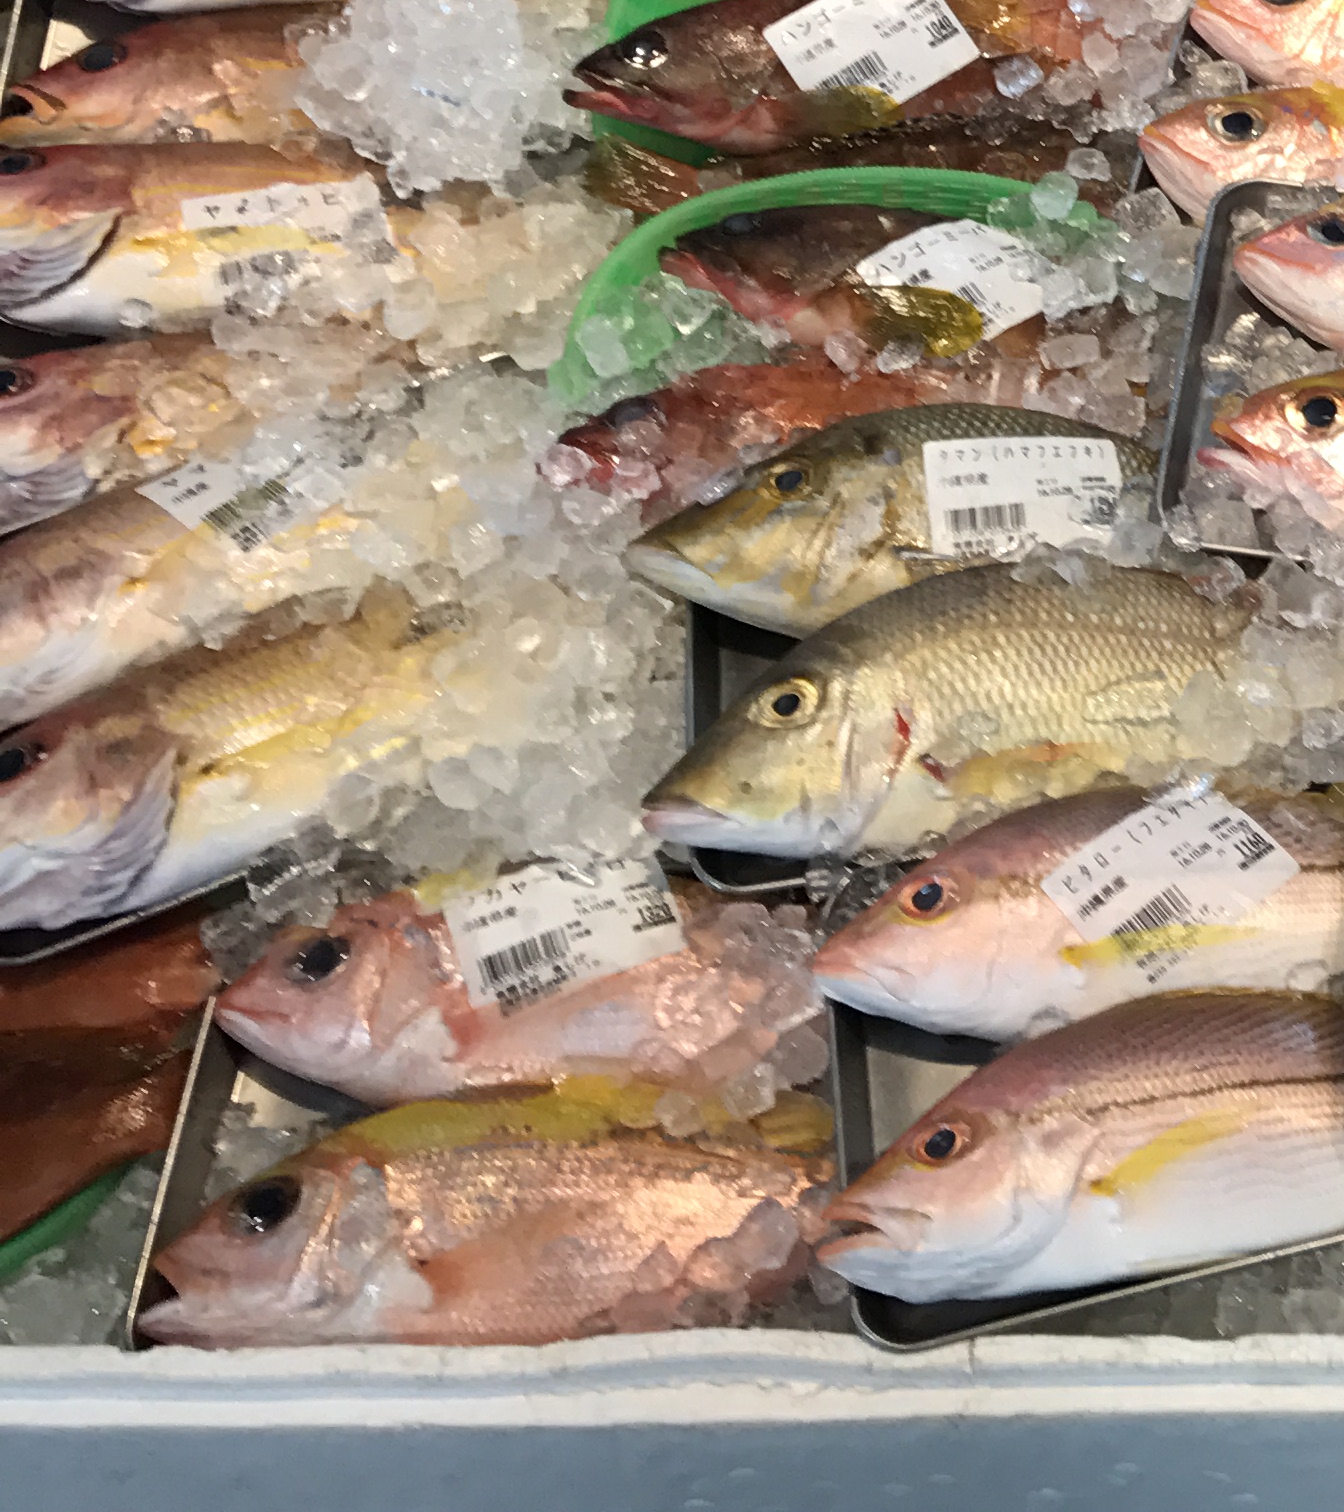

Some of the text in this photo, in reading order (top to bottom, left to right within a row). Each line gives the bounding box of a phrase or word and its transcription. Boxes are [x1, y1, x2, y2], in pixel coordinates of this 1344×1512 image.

[926, 15, 954, 40] 1040
[875, 226, 985, 276] ハンゴーミーバ
[1233, 833, 1268, 860] 1160
